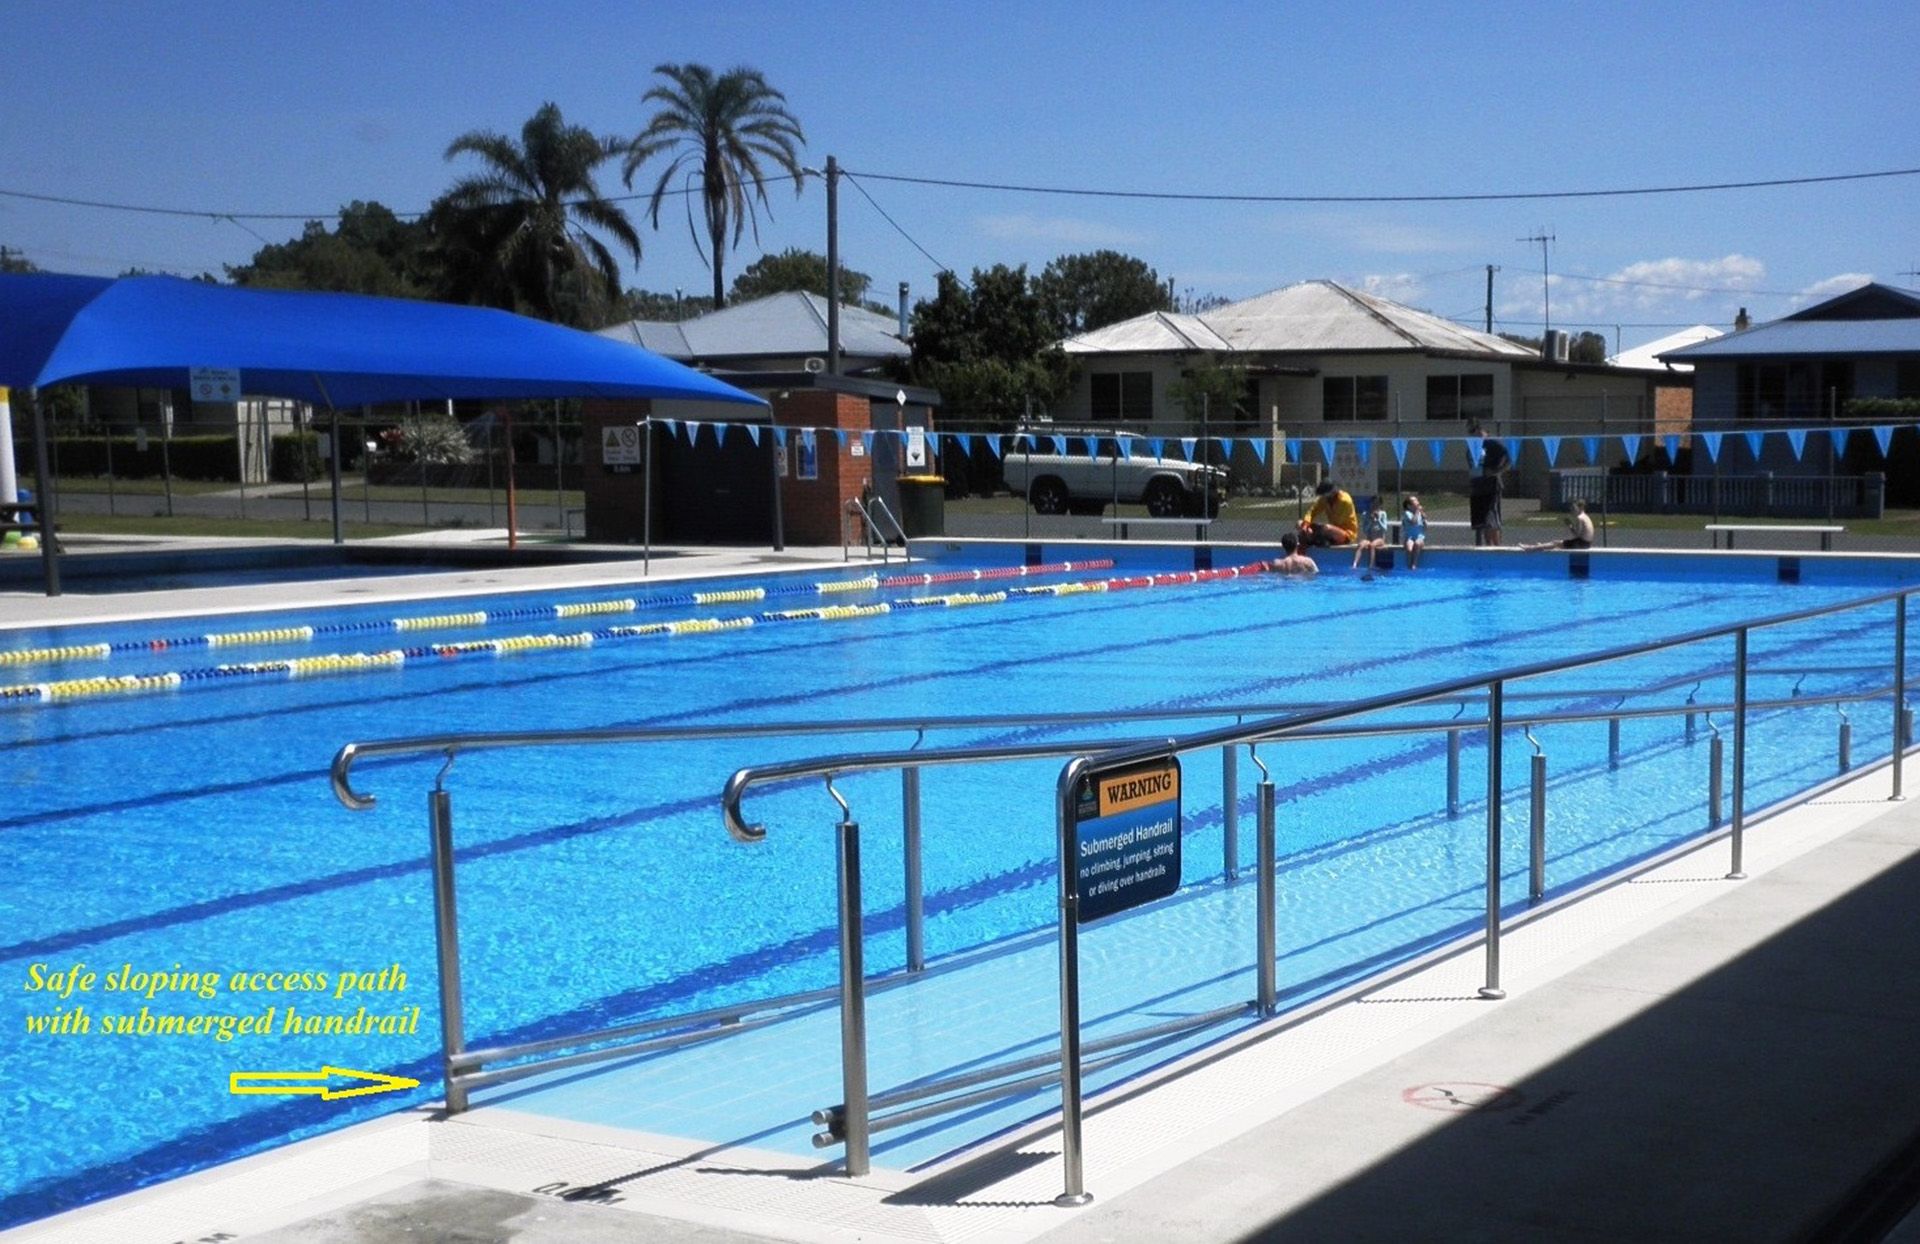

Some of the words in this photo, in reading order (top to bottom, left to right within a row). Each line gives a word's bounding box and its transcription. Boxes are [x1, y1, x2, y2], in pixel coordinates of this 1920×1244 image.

[1107, 773, 1171, 804] WARNING
[1080, 828, 1134, 857] Submerged
[1136, 817, 1173, 841] Handrail
[1080, 867, 1090, 879] no
[1153, 842, 1174, 857] sitting
[1089, 886, 1097, 897] or
[1097, 879, 1119, 894] diving
[1119, 875, 1134, 887] over
[1135, 864, 1166, 882] handrails
